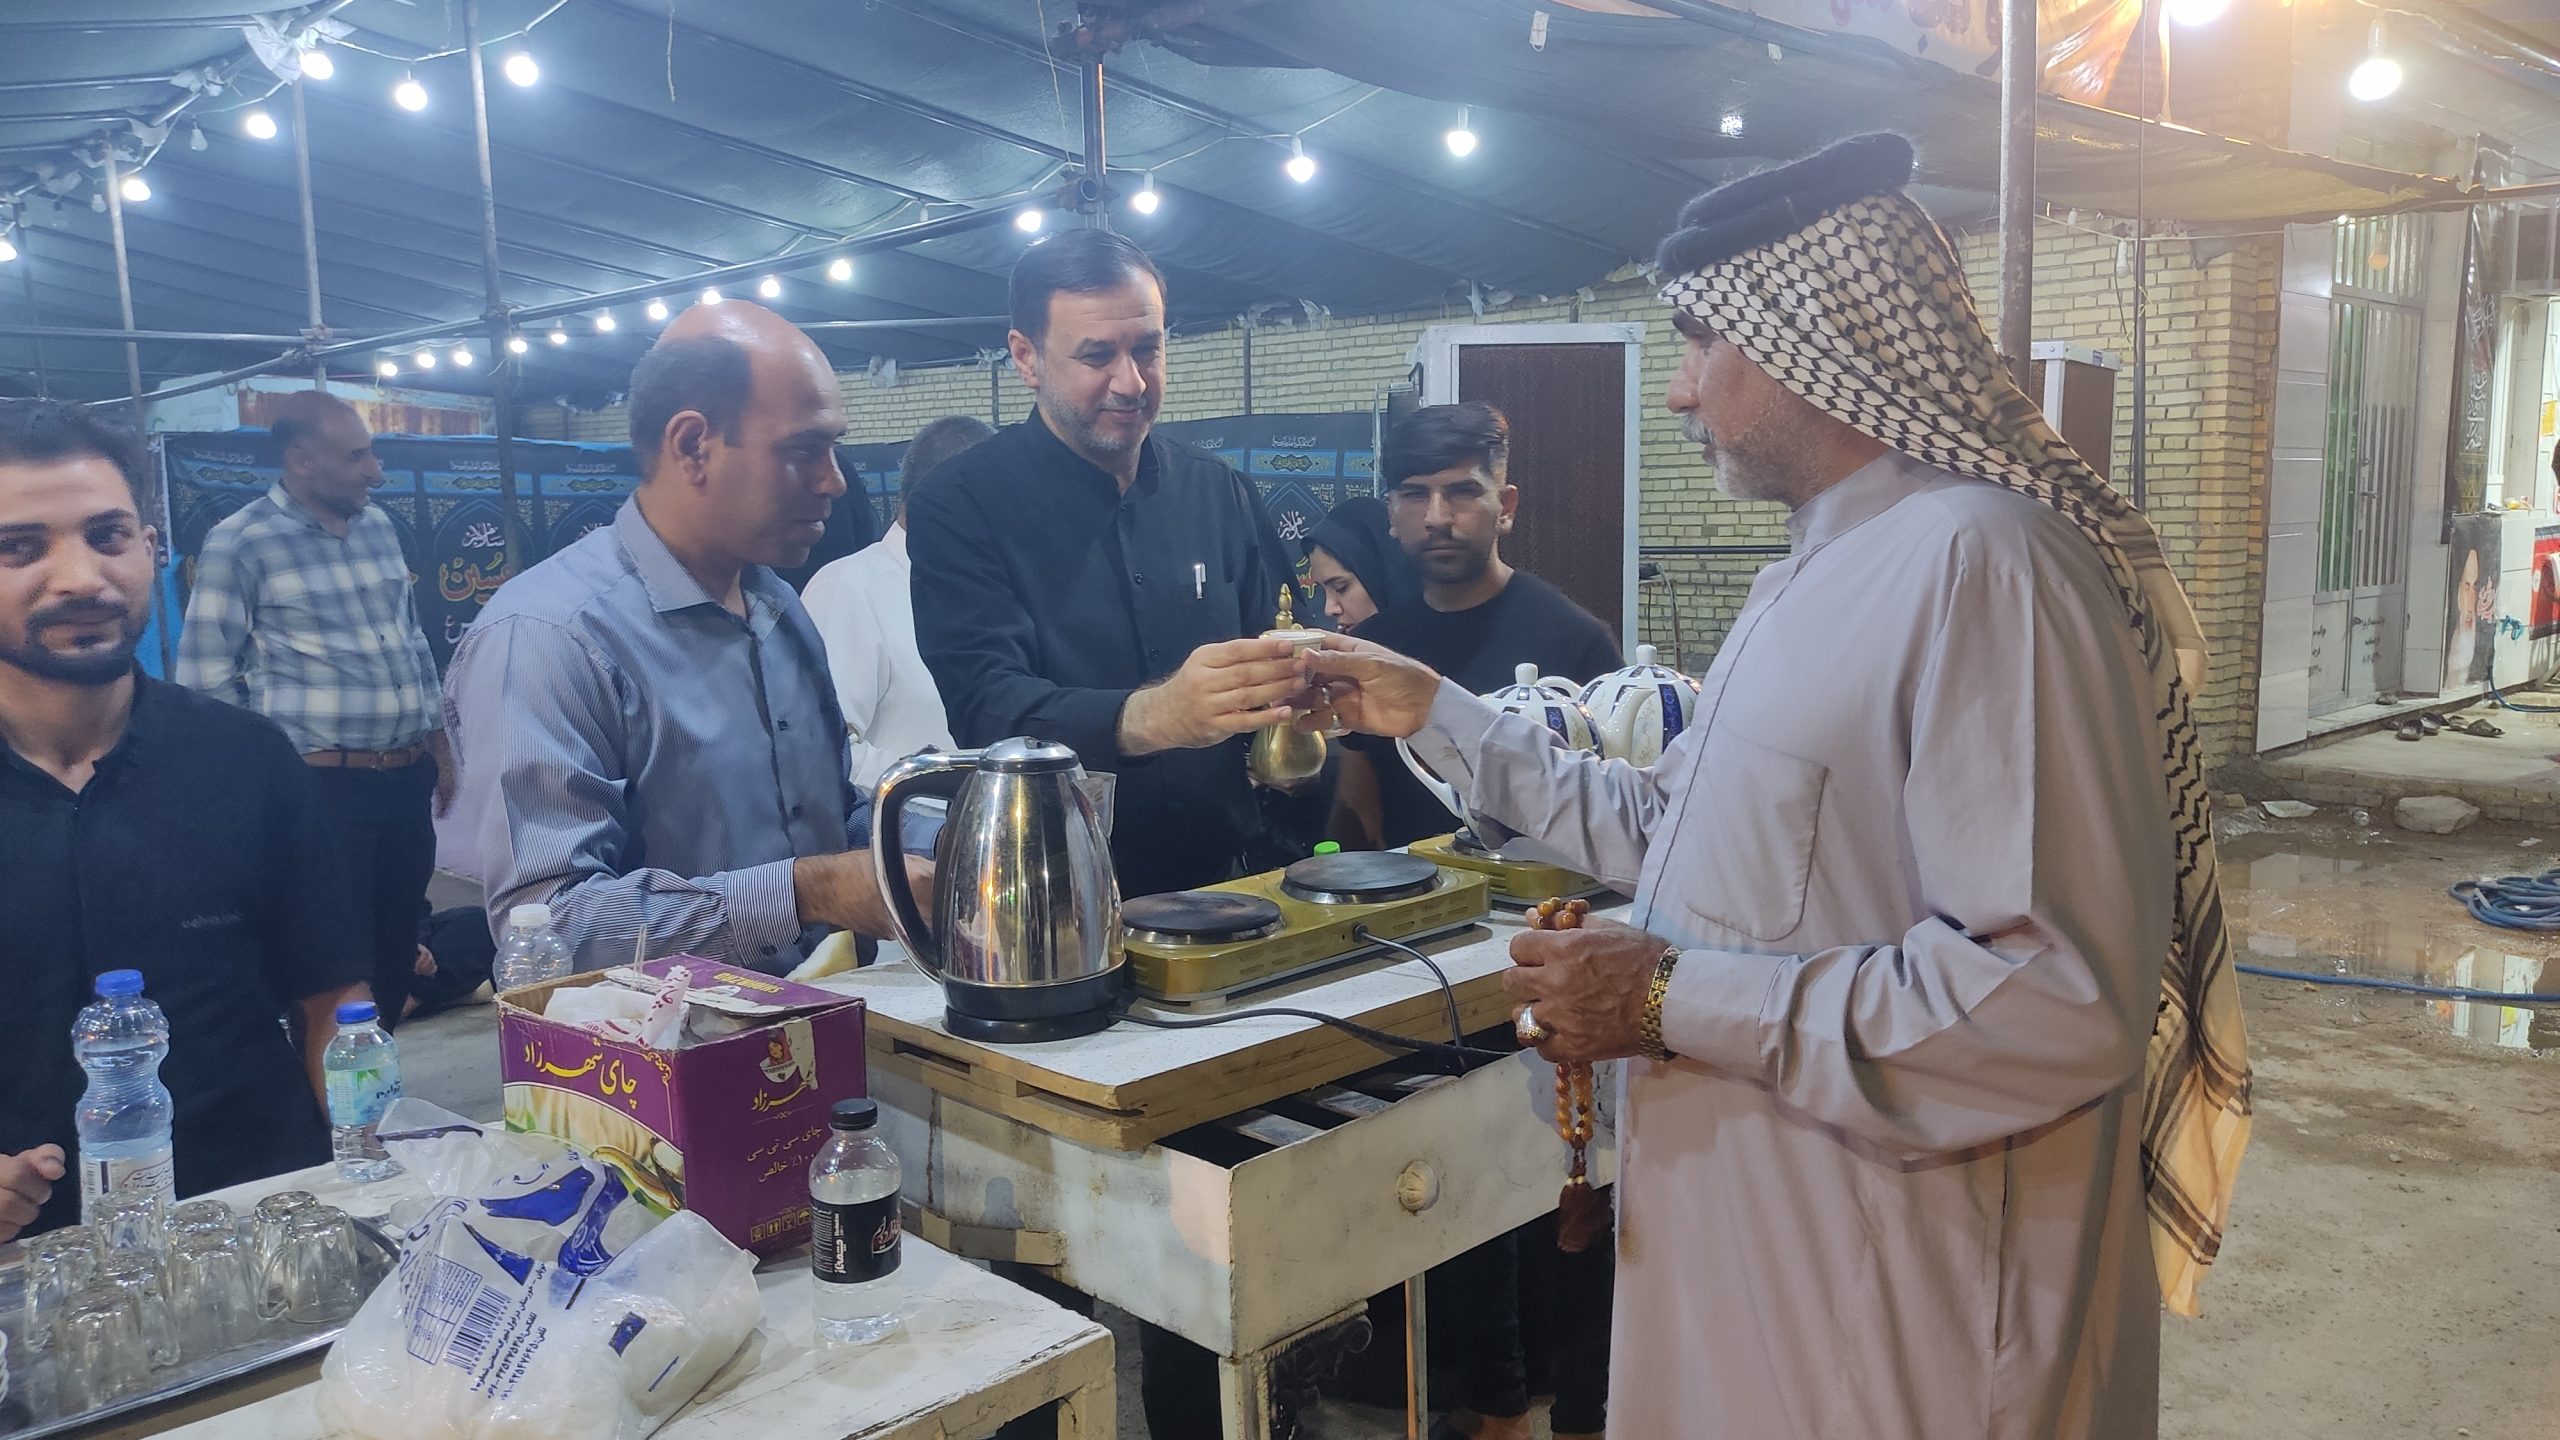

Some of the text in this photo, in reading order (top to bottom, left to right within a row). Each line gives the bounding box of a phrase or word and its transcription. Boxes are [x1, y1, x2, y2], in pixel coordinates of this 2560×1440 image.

[524, 1037, 638, 1110] چای شهرزاد
[801, 1126, 823, 1142] چای
[759, 1160, 789, 1182] خالص
